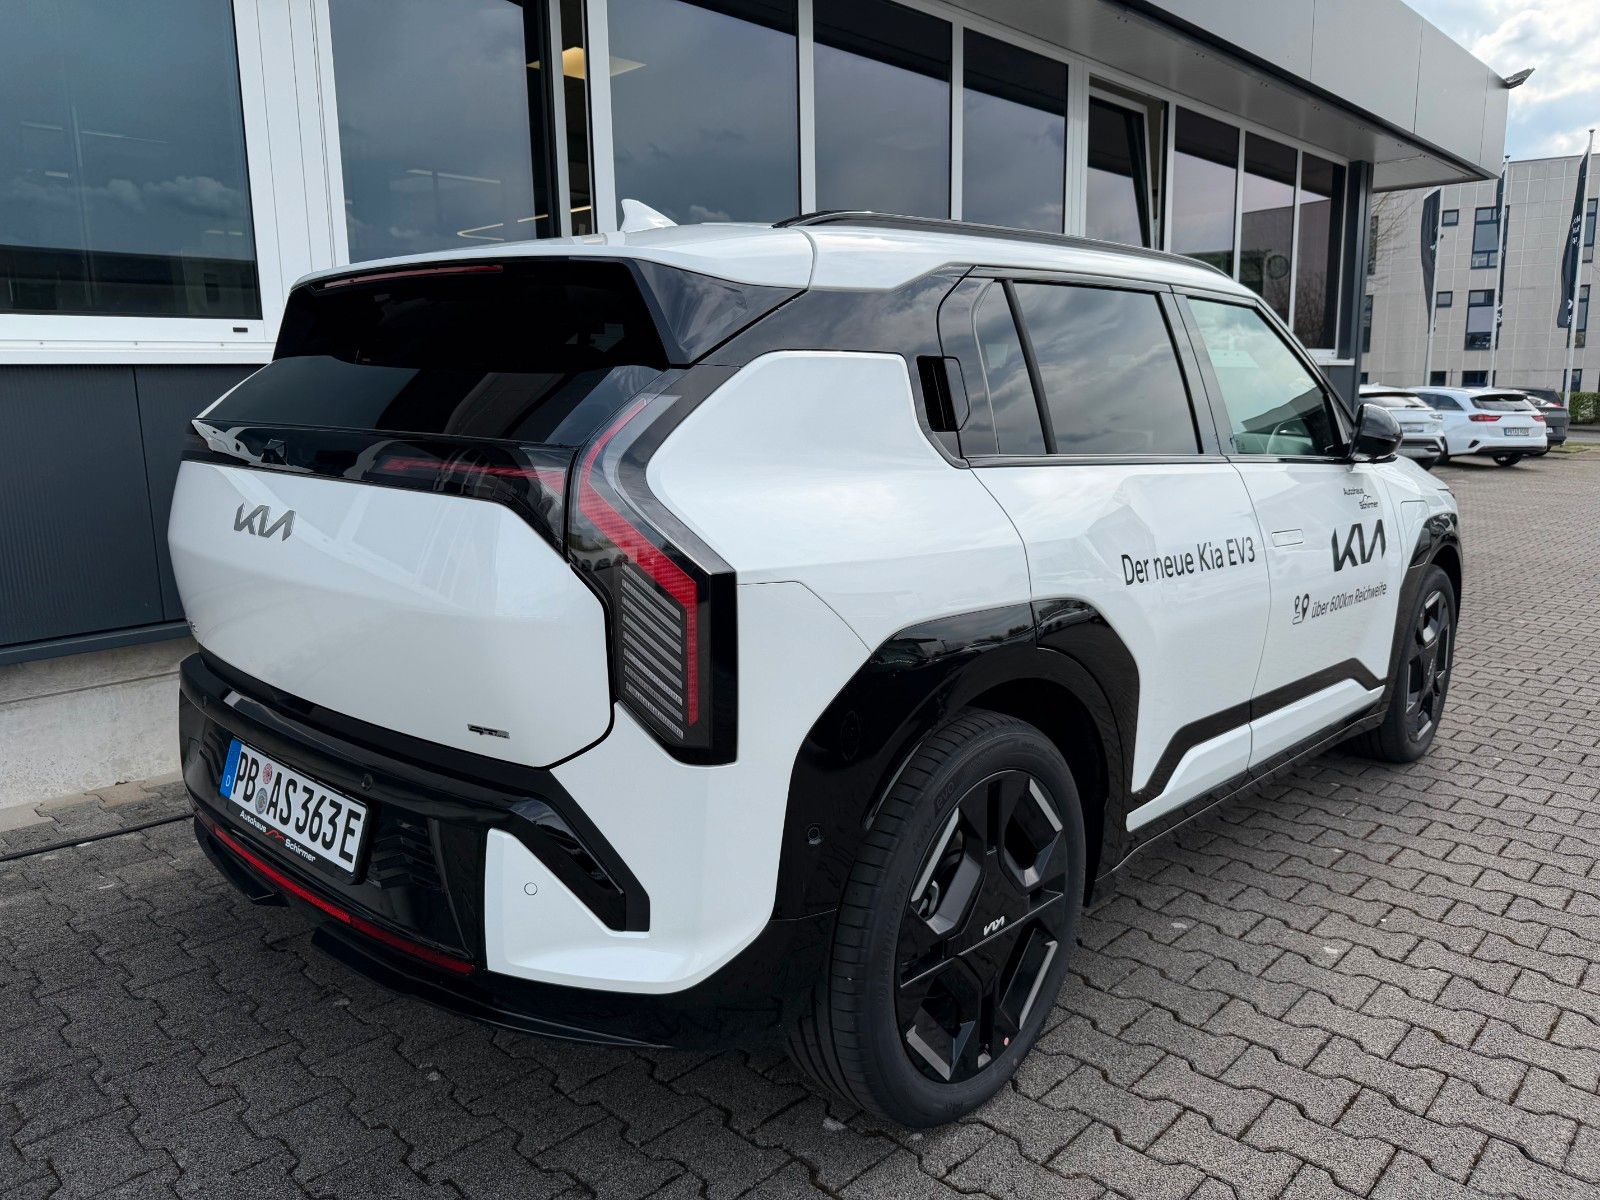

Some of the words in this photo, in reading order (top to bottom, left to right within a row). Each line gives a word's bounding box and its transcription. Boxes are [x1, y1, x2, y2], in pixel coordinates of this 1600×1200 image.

[234, 502, 297, 541] KIA
[1331, 518, 1387, 572] KIA
[1121, 553, 1149, 586] Der
[1153, 552, 1195, 580] neue
[1196, 541, 1224, 572] Kia
[1225, 536, 1256, 567] EV3
[1311, 601, 1329, 619] über
[1353, 582, 1387, 604] Reichweite
[233, 751, 260, 803] PB
[240, 810, 267, 833] Autohaus
[285, 838, 316, 863] Schirmer
